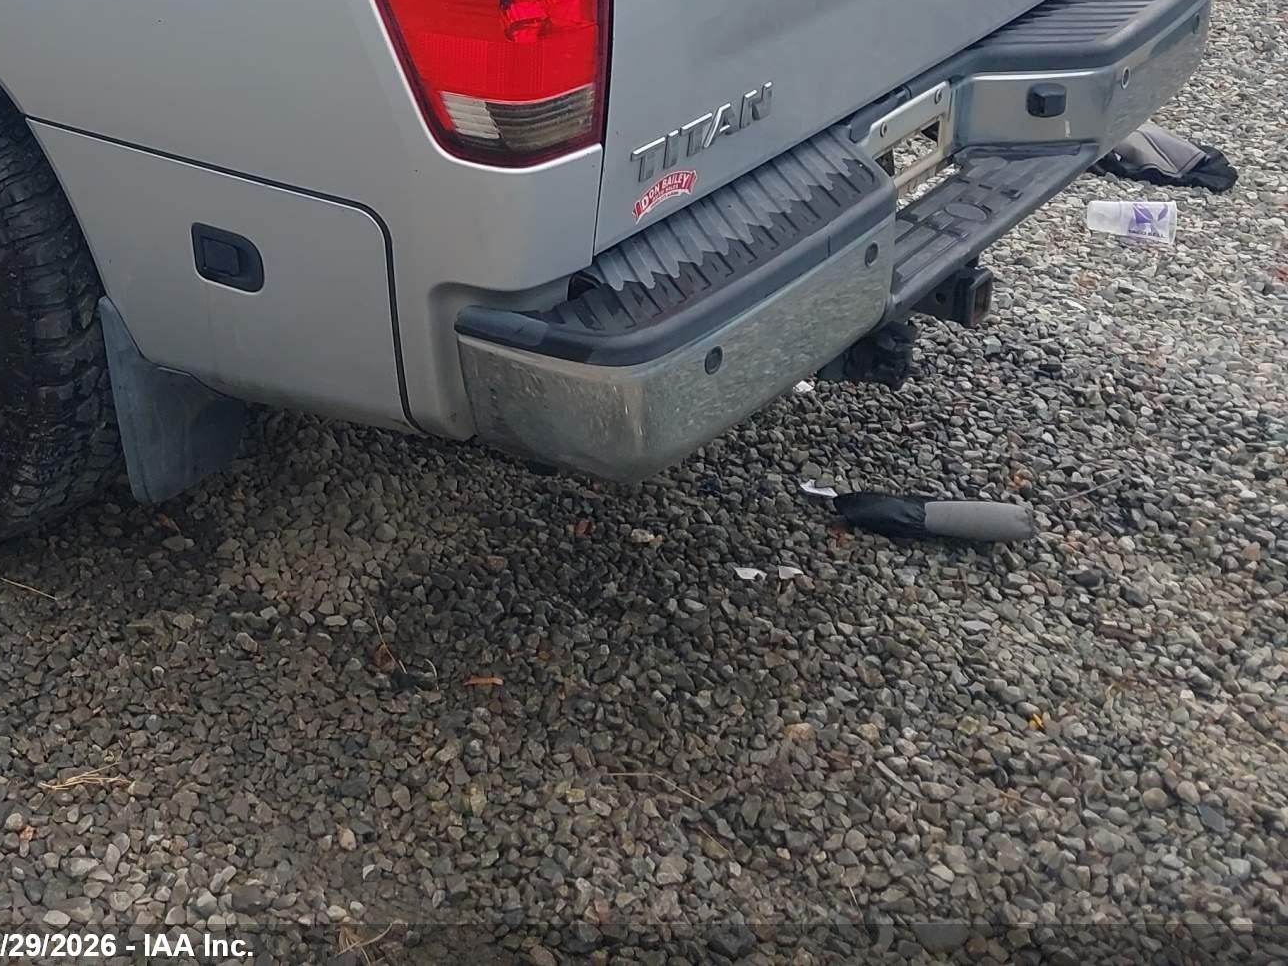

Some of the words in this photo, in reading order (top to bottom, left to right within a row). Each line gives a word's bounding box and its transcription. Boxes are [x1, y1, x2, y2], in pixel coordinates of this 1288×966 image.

[630, 81, 773, 183] TITAN
[641, 183, 660, 209] DON
[661, 172, 689, 189] BAILEY
